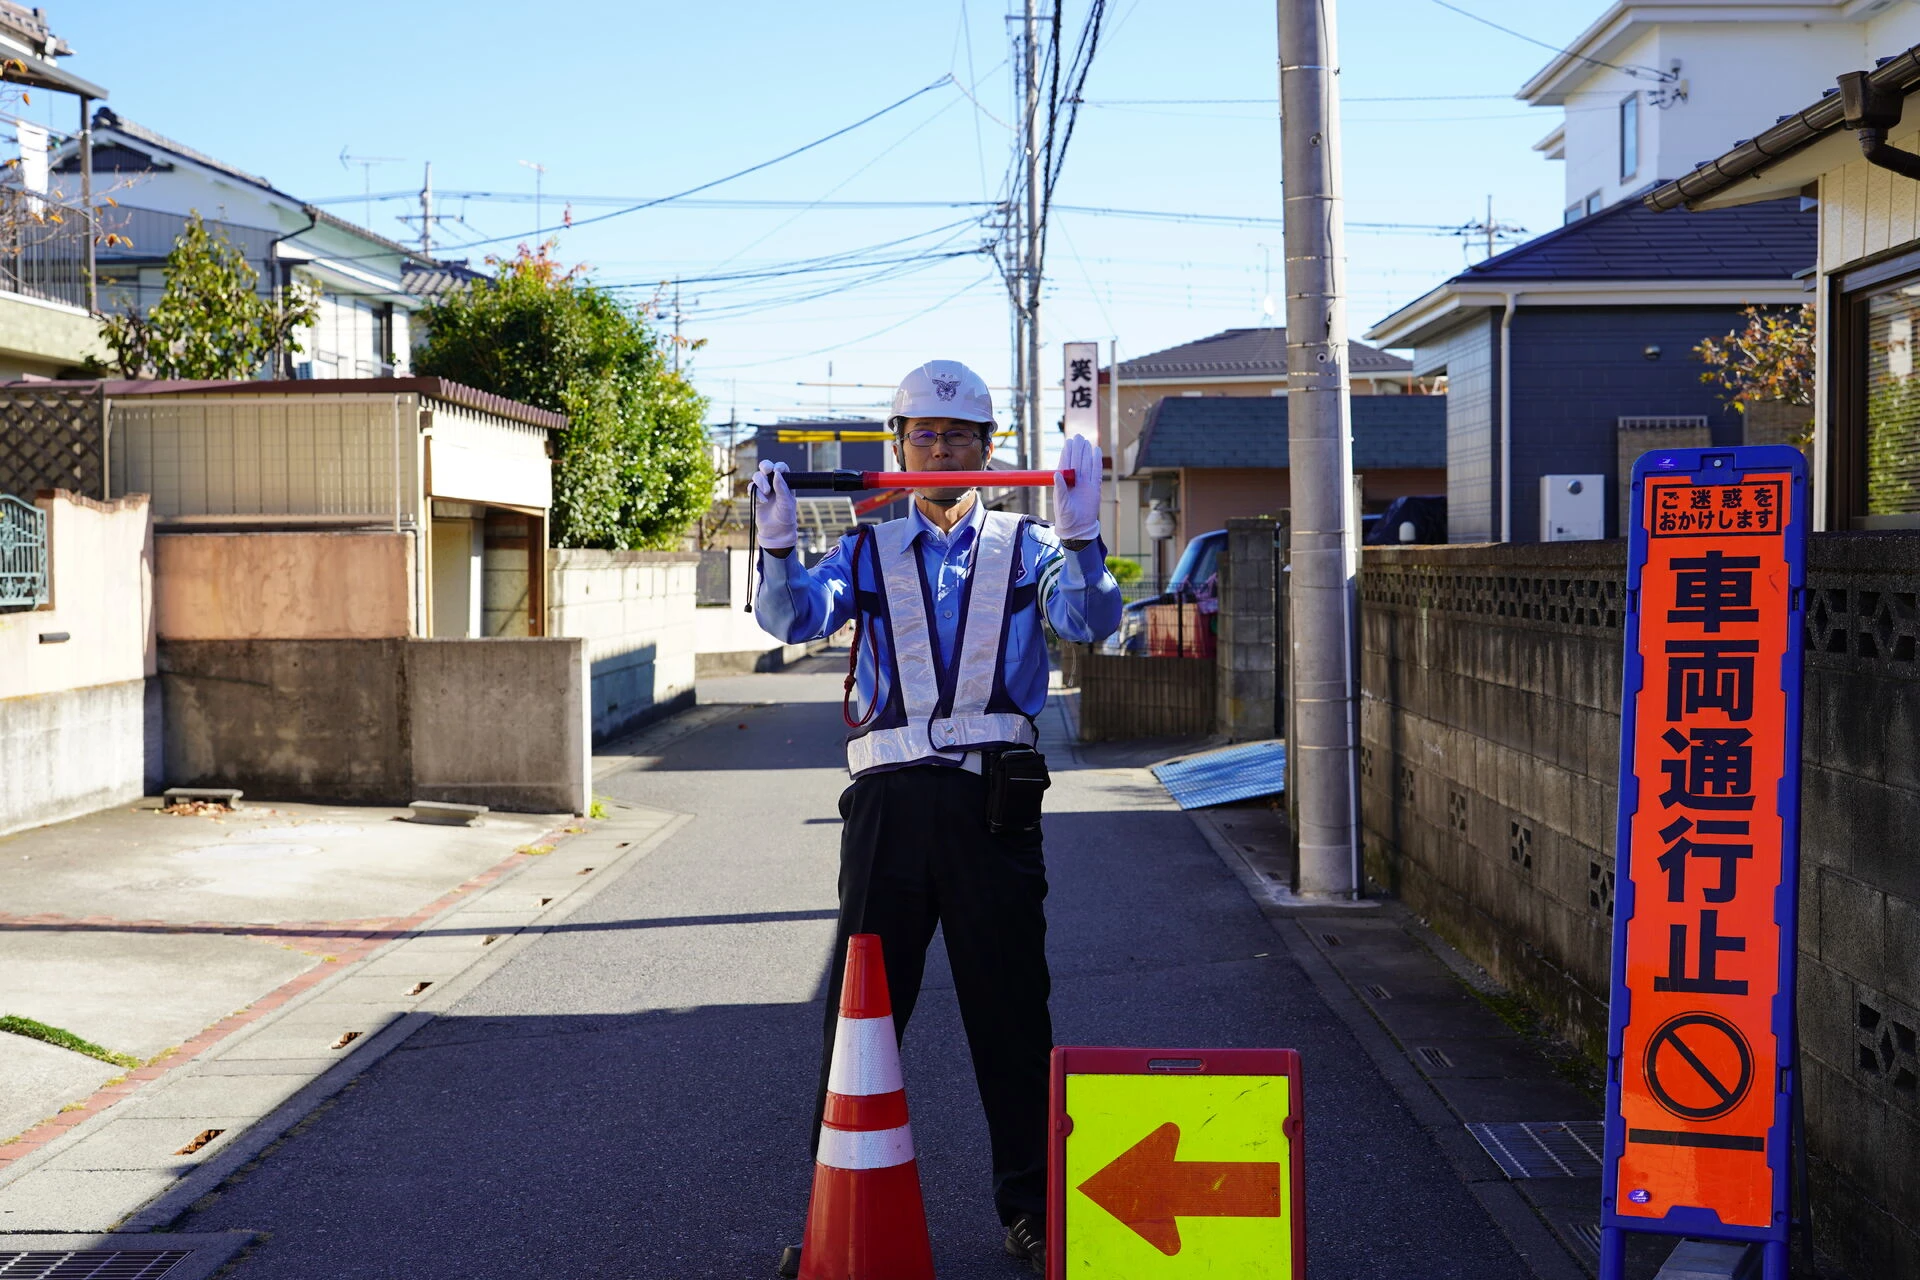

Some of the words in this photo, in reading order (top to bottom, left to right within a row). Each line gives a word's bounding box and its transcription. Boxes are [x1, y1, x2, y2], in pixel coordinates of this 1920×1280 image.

[1662, 487, 1773, 510] ご迷惑を
[1659, 508, 1774, 531] おかけします
[1654, 550, 1761, 996] 車両通行止
